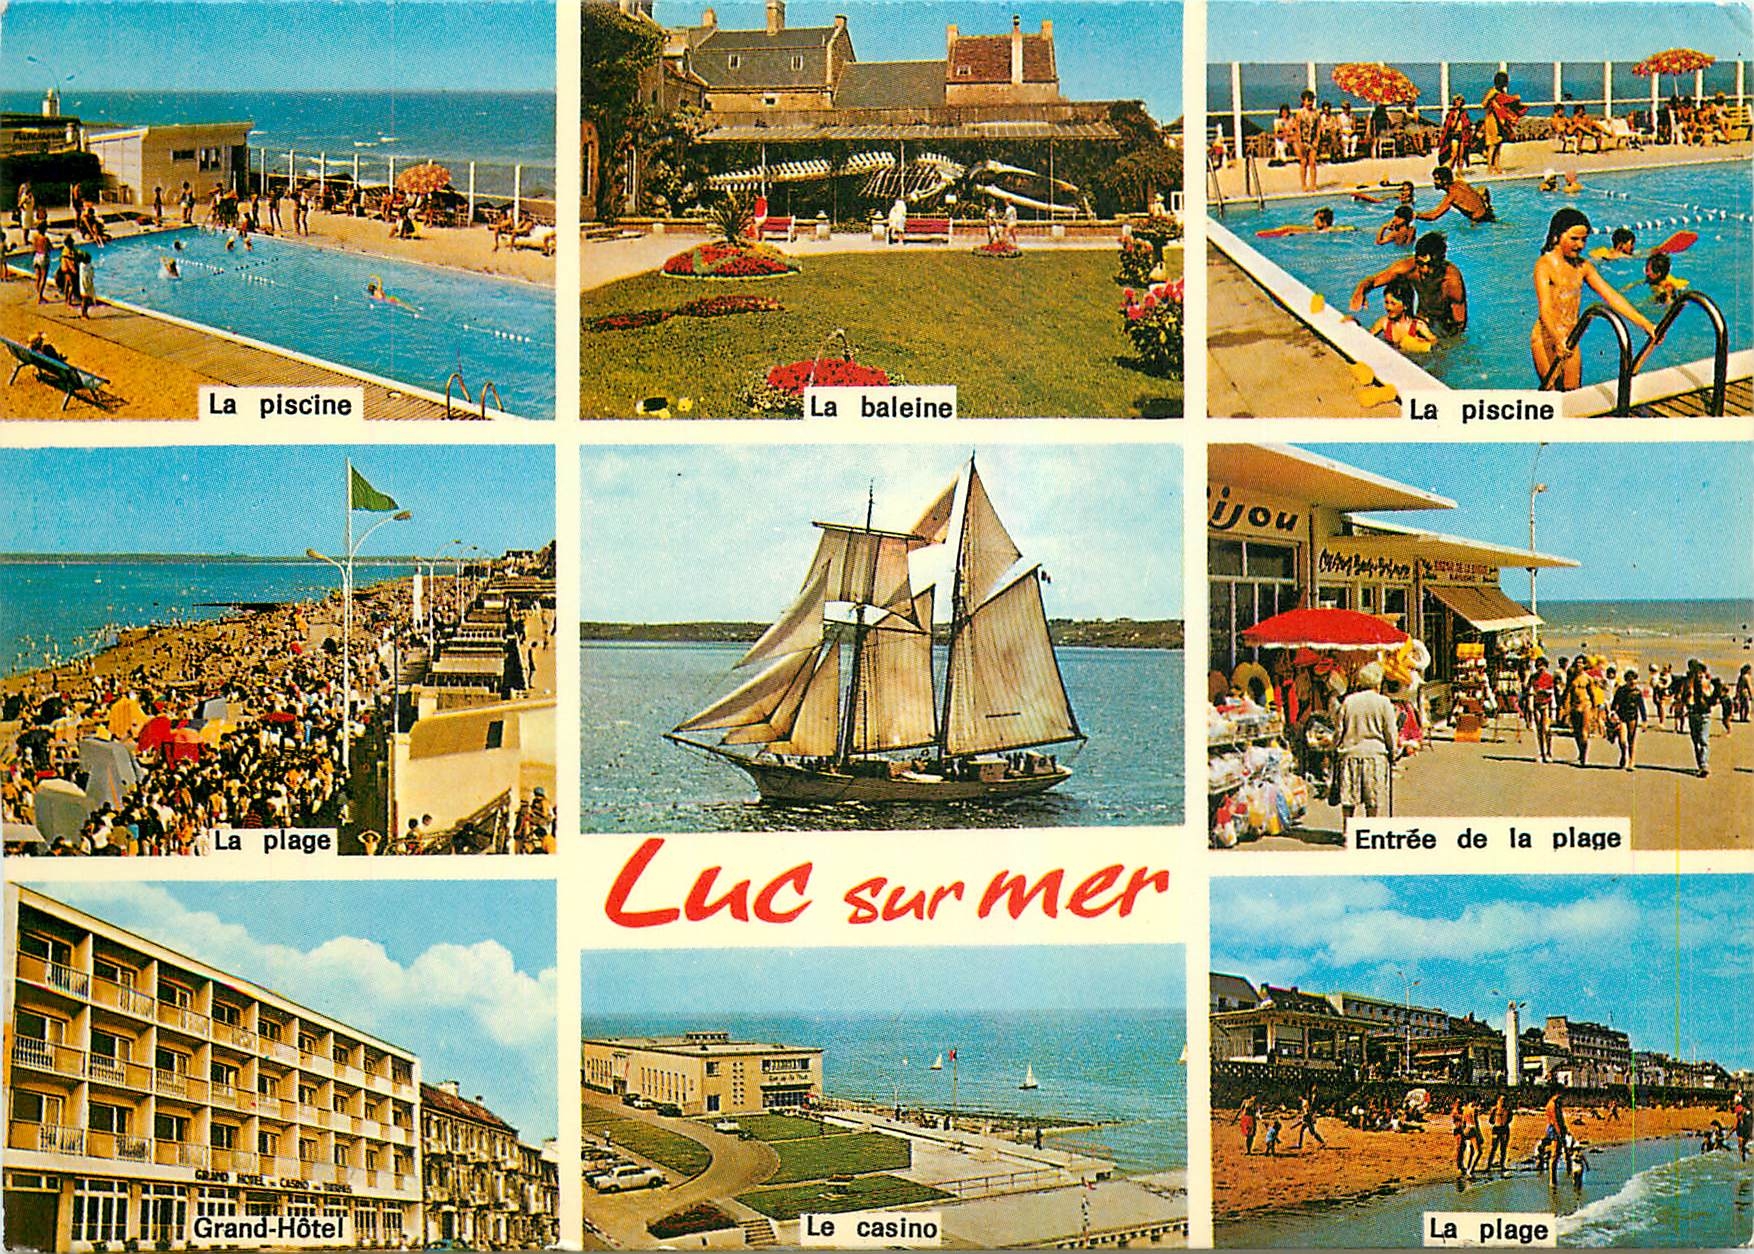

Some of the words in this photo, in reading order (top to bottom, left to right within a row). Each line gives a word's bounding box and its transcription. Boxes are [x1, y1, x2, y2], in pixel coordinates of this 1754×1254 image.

[1207, 485, 1298, 531] ijou
[195, 1169, 229, 1183] GRAND
[237, 1173, 264, 1187] HOTEL
[280, 1178, 310, 1191] CASINO
